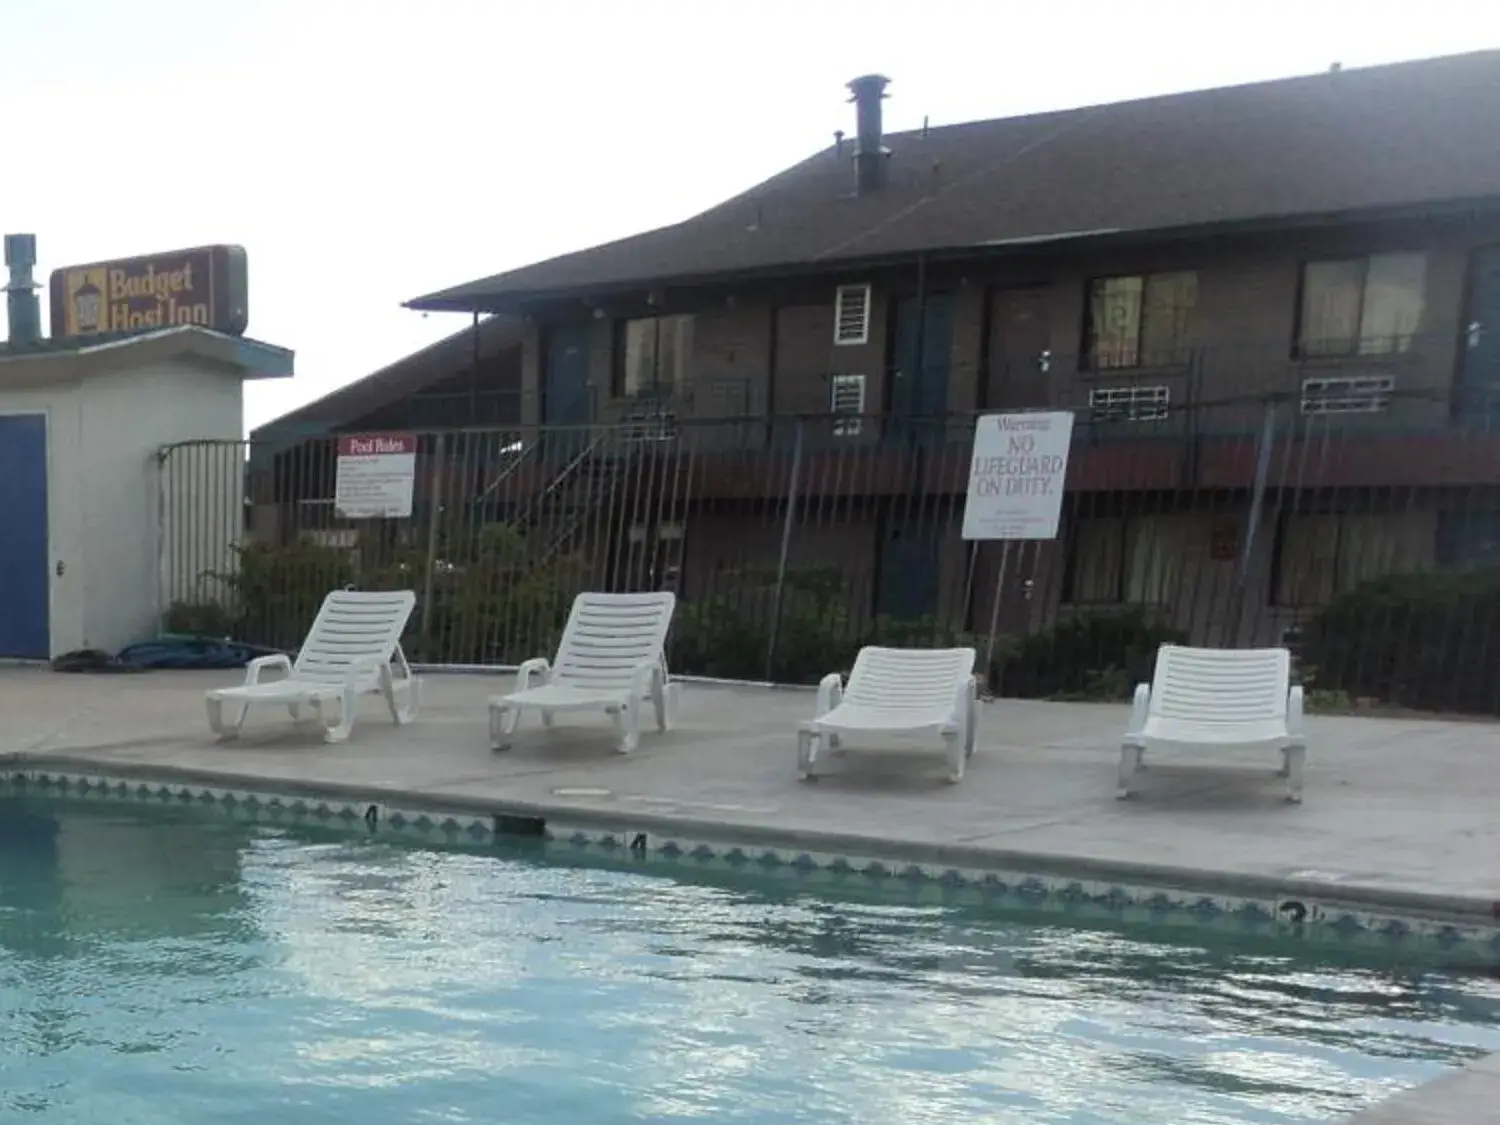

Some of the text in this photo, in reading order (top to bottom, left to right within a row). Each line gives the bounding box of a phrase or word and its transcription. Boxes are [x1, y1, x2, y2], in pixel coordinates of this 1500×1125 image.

[111, 262, 193, 301] Budget
[112, 298, 208, 330] Host Inn
[350, 436, 405, 454] Pool Rules
[1007, 434, 1035, 455] NO
[974, 455, 1063, 476] LIFEGUARD
[977, 477, 1000, 496] ON
